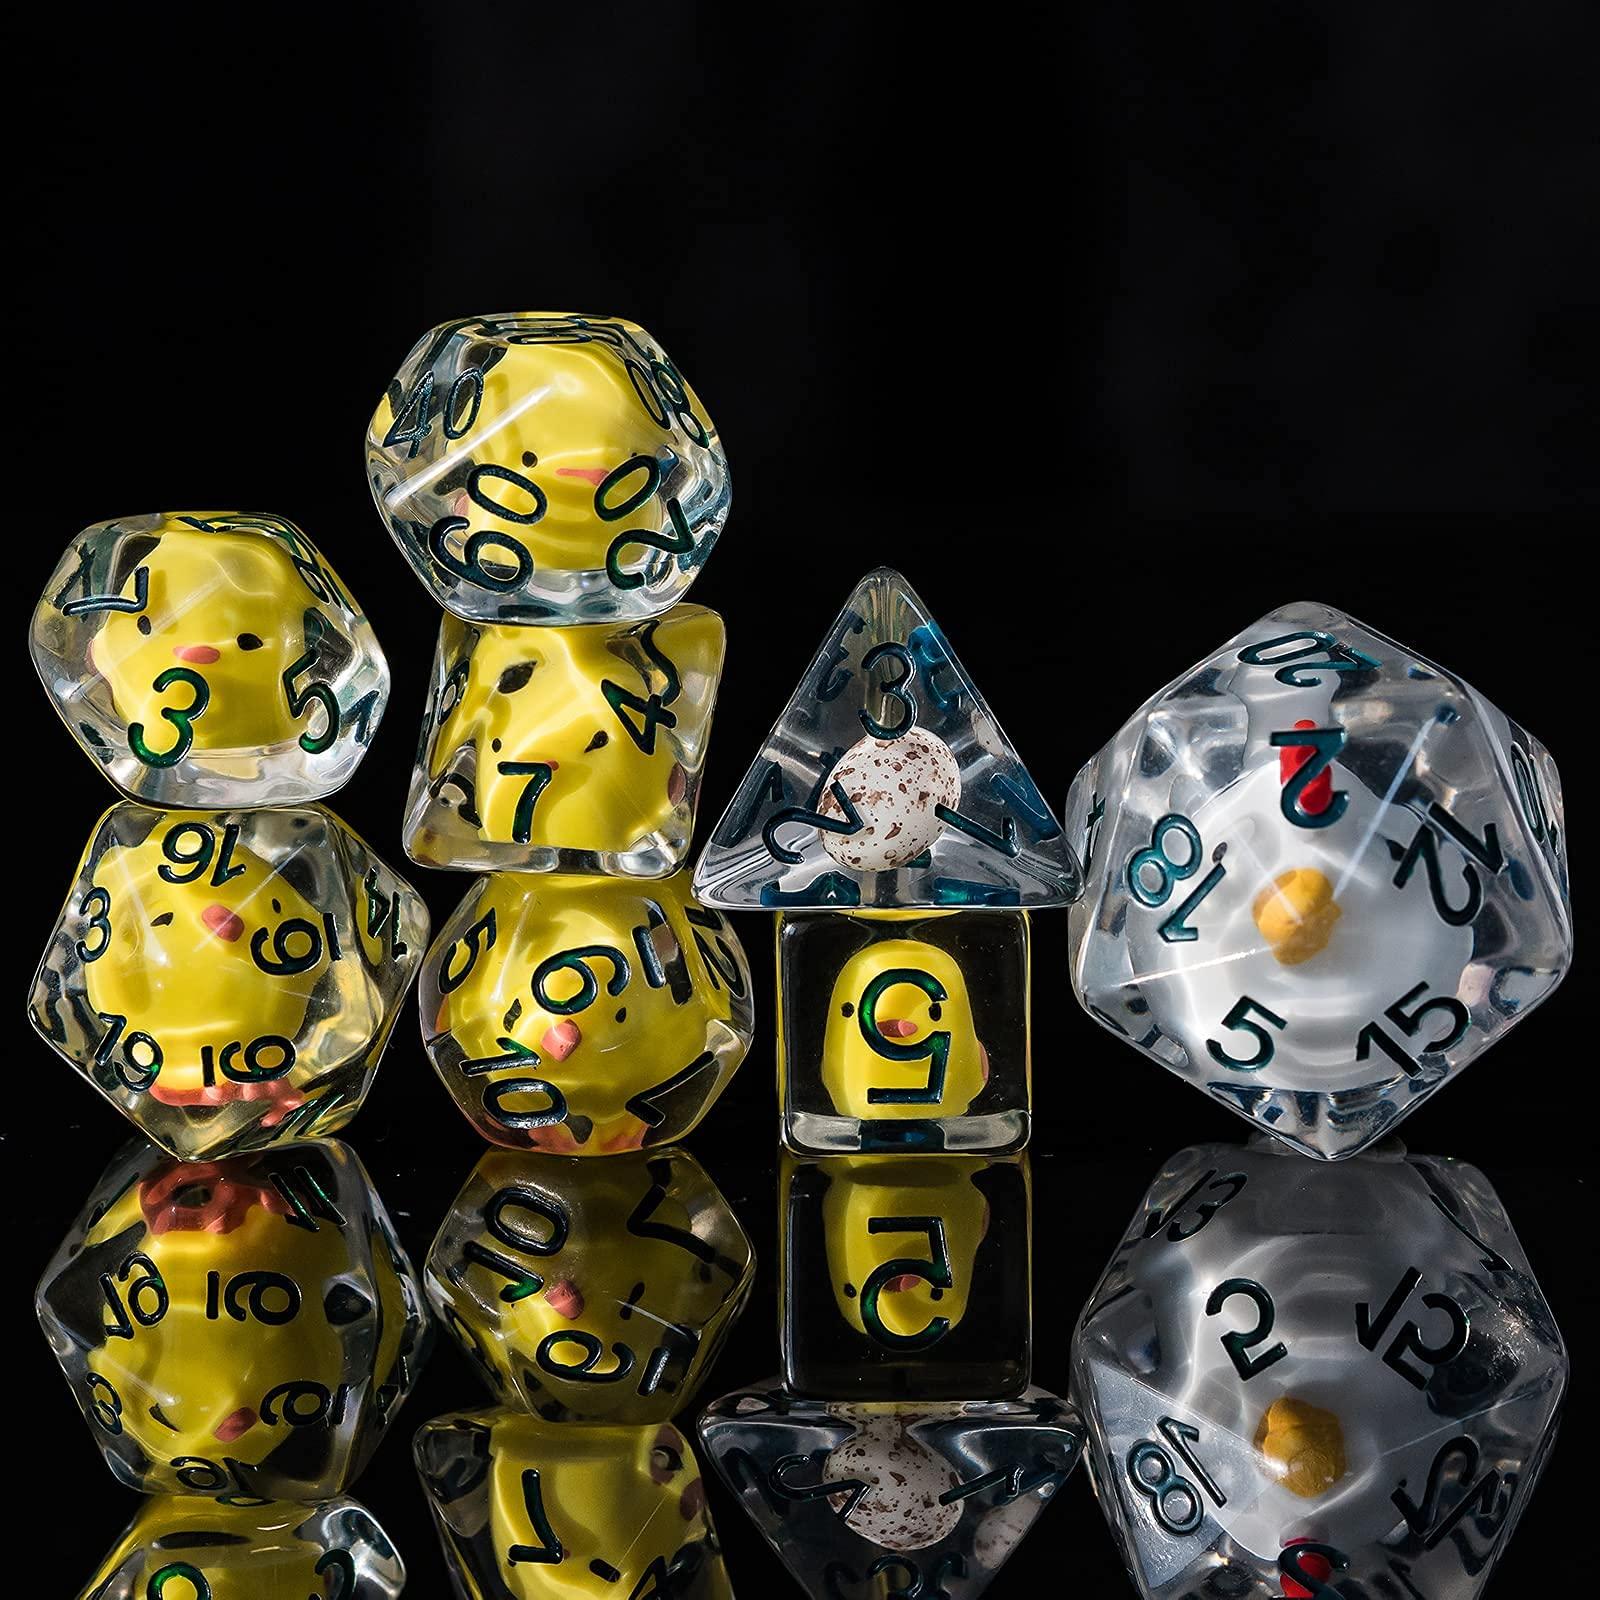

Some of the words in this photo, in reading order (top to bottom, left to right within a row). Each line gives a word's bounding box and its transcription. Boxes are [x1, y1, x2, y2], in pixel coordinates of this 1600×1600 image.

[382, 366, 485, 459] 40
[625, 357, 710, 449] 80
[428, 463, 548, 594] 60
[593, 454, 696, 591] 20
[127, 666, 211, 769] 3
[282, 649, 341, 755] 5
[600, 678, 678, 756] 4
[857, 641, 918, 741] 3
[497, 761, 552, 844] 7
[761, 779, 864, 865] 2
[1270, 727, 1350, 830] 2
[1127, 812, 1228, 944] 18
[1392, 799, 1504, 928] 12
[75, 886, 111, 963] 3
[438, 906, 498, 995] 5
[93, 1011, 163, 1093] 19
[1205, 995, 1288, 1073] 5
[1354, 981, 1474, 1079] 15
[458, 1036, 569, 1129] 10
